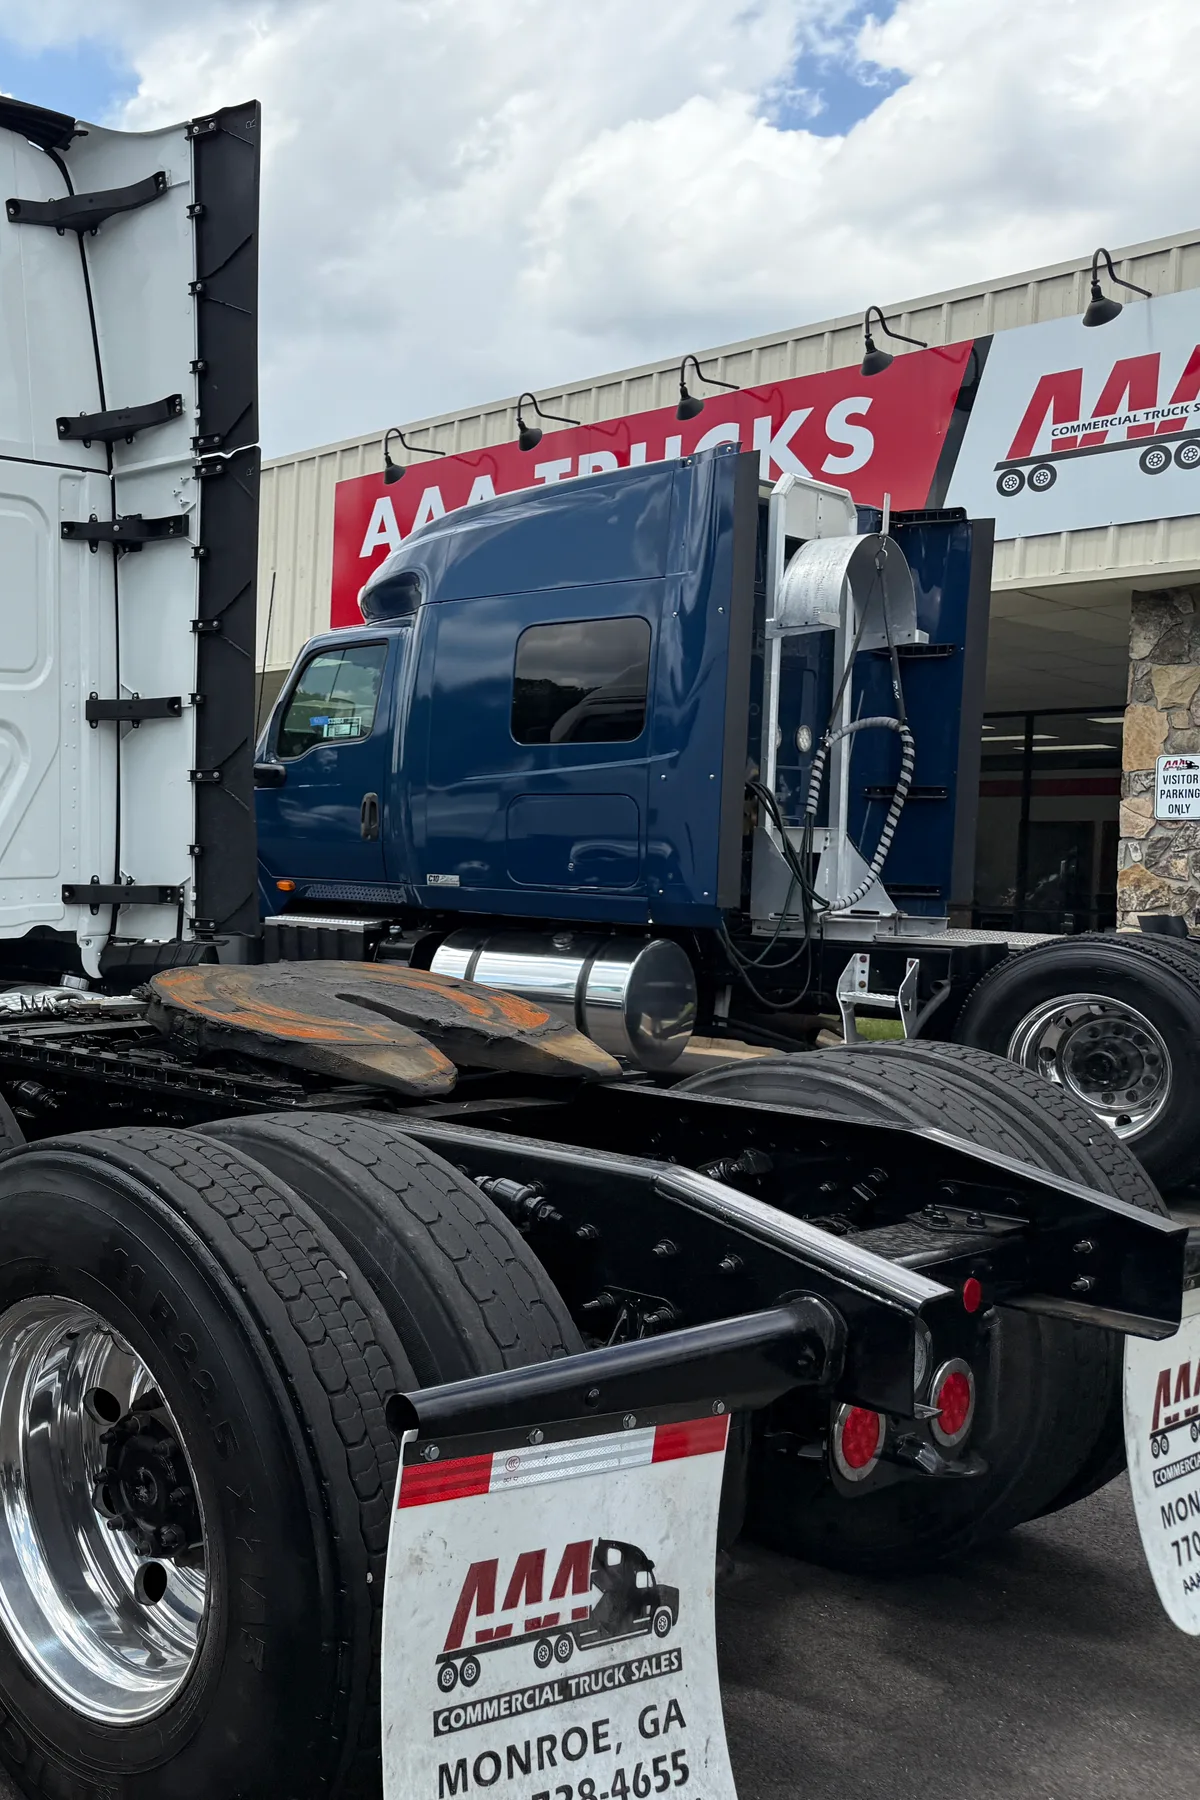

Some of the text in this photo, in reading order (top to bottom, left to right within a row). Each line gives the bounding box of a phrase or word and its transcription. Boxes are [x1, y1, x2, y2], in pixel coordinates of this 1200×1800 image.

[1051, 414, 1140, 437] COMMERCIAL
[1144, 404, 1190, 421] TRUCK
[1160, 788, 1200, 799] PARKING
[1163, 774, 1199, 785] VISITOR
[1168, 803, 1191, 815] ONLY
[1152, 1359, 1200, 1432] AA
[443, 1539, 594, 1653] AAA
[437, 1650, 680, 1732] COMMERCIAL TRUCK SALES
[438, 1698, 687, 1799] MONROE, GA
